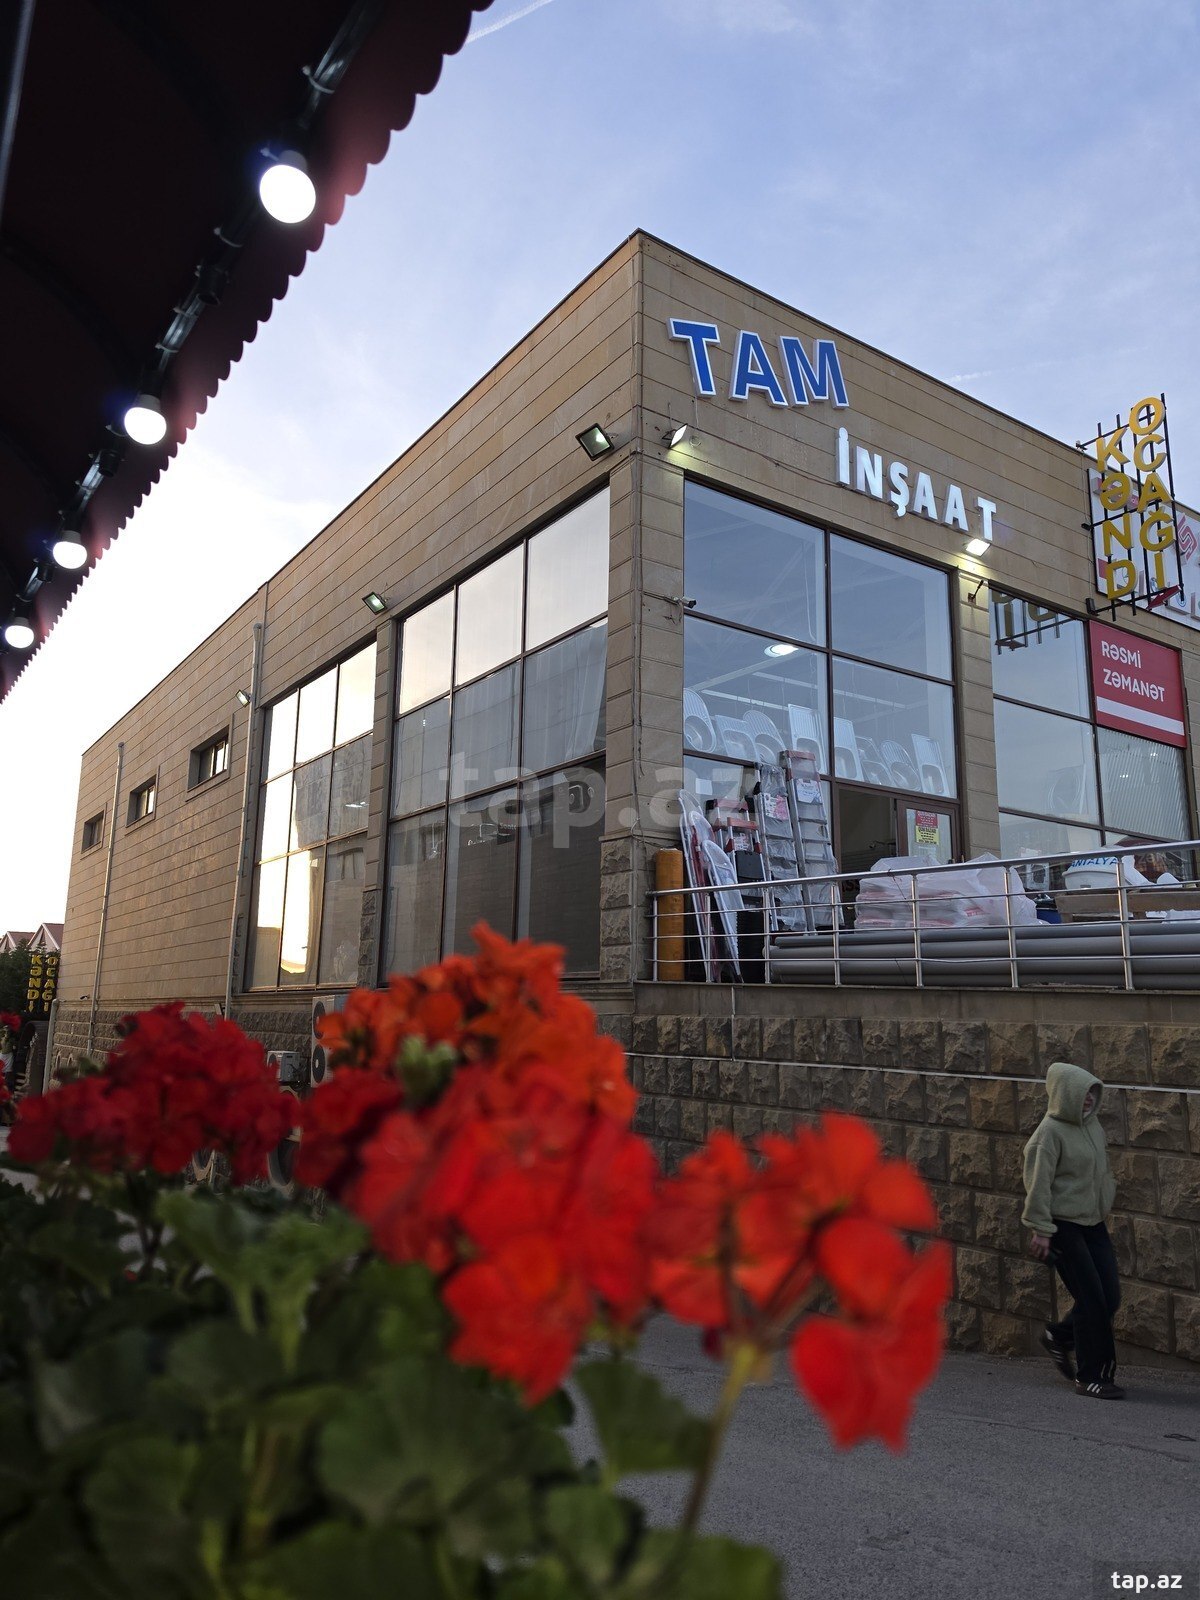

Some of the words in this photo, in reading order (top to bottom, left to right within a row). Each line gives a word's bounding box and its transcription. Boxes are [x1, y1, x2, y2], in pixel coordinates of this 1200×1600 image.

[667, 317, 850, 409] TAM
[835, 427, 996, 541] İNŞAAT
[1101, 640, 1142, 668] RƏSMİ
[1103, 668, 1165, 702] ZƏMANƏT
